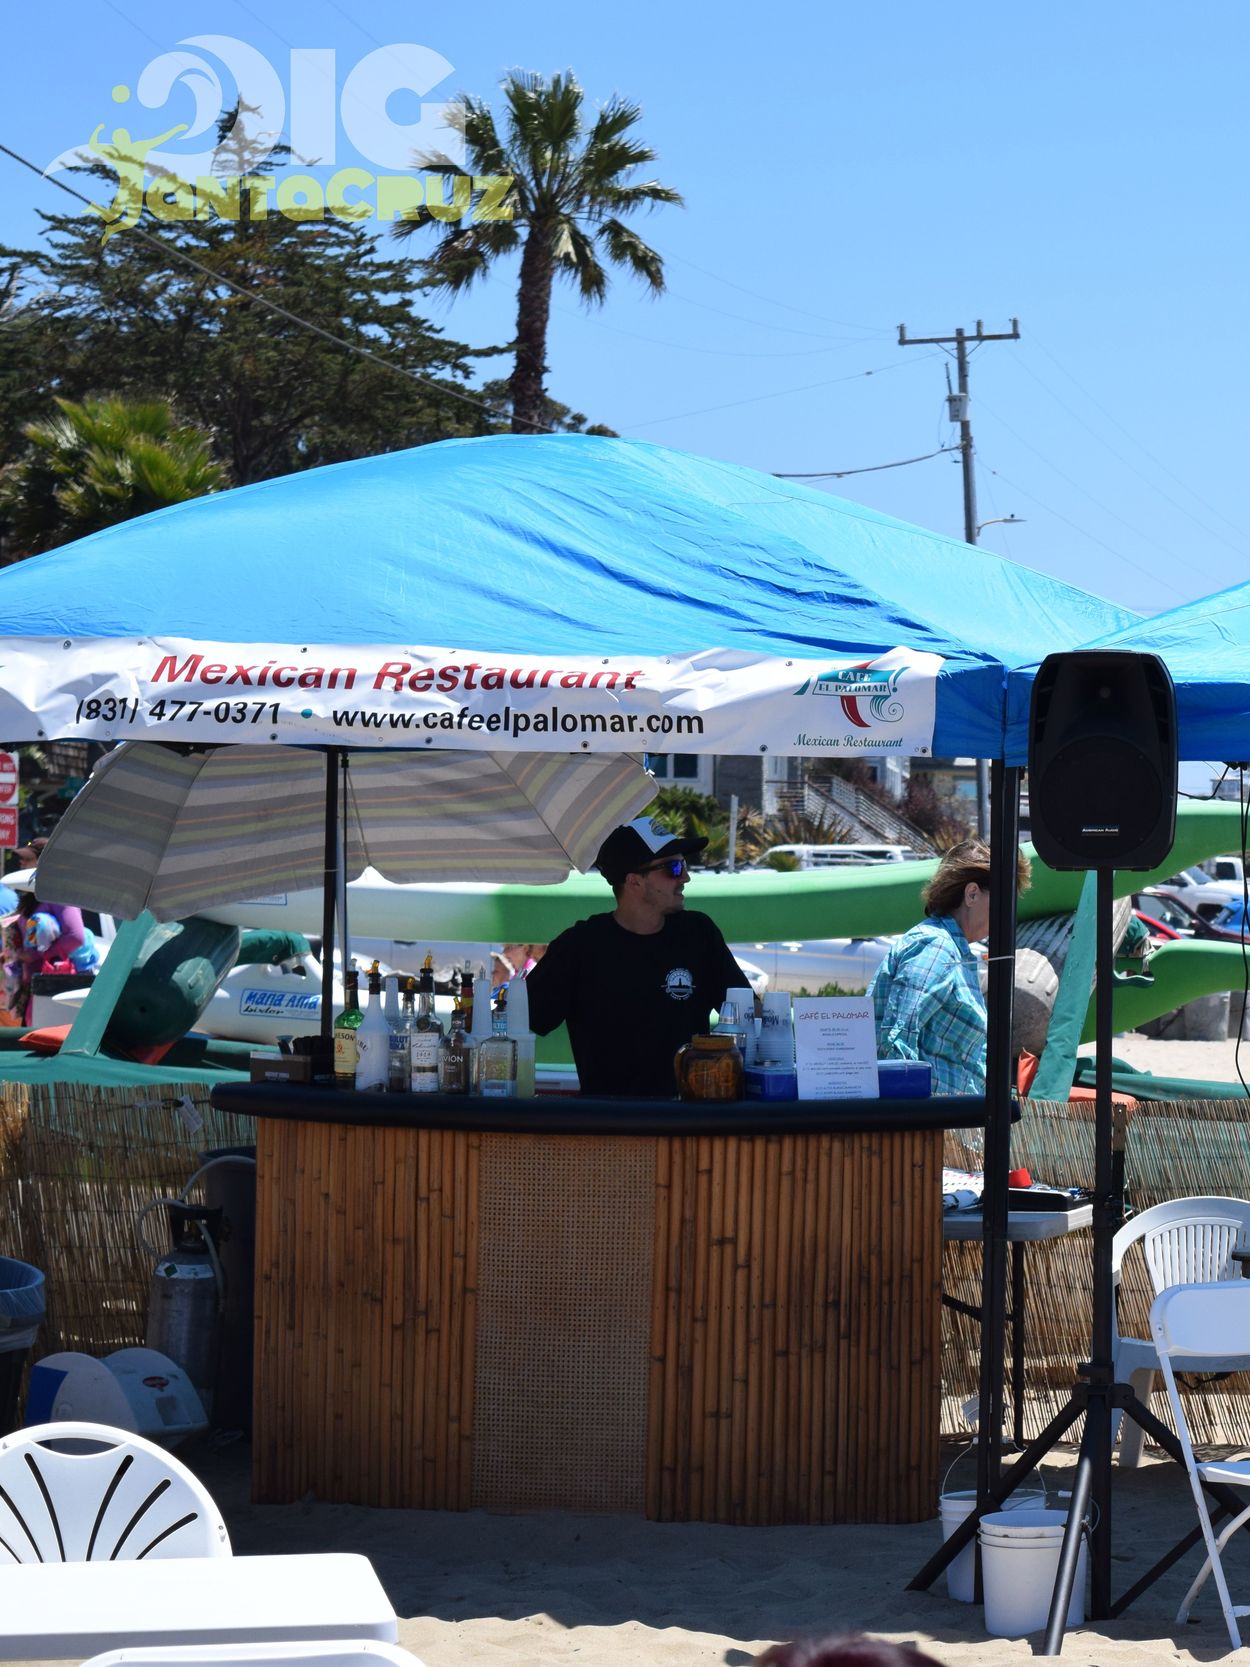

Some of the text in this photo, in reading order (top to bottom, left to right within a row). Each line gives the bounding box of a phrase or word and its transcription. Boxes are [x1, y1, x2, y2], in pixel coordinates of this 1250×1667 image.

[150, 653, 646, 693] Mexican Restaurant
[818, 683, 887, 693] EL PALOMAR
[75, 697, 704, 738] (831) 477-0371 www.cafeelpalomar.com
[793, 733, 903, 747] Mexican Restaurant
